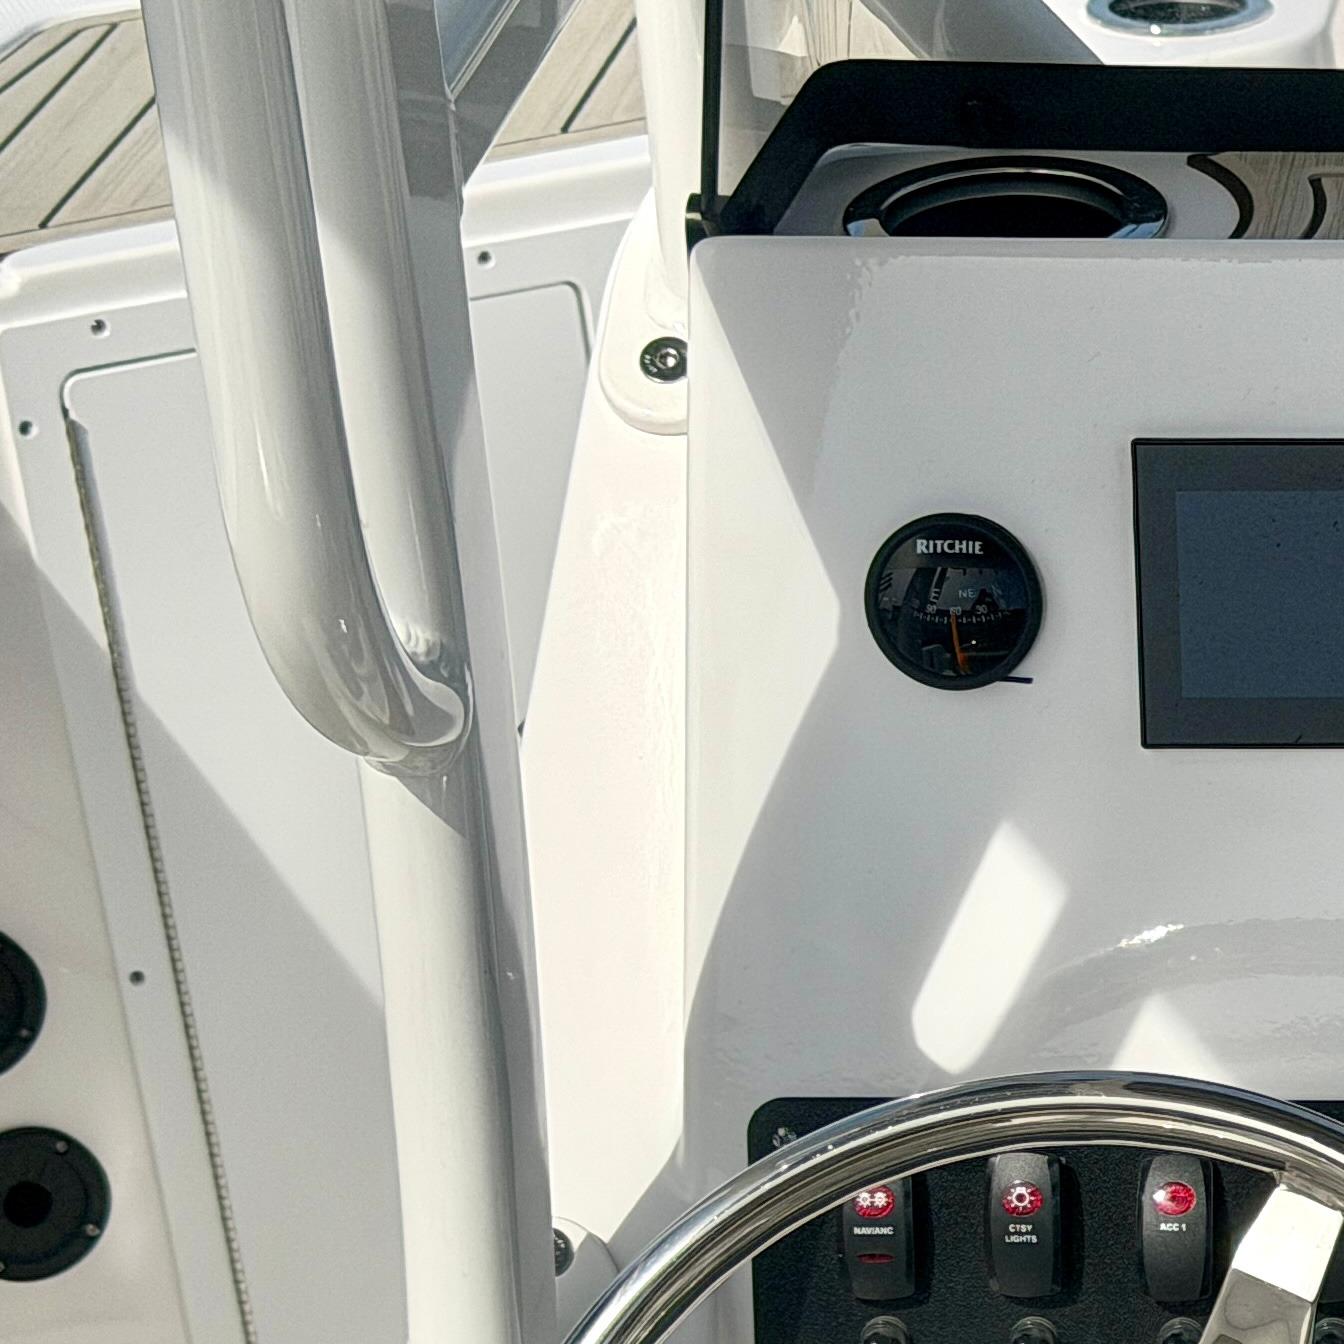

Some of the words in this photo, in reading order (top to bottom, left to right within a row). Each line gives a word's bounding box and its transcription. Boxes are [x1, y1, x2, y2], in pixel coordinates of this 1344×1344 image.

[916, 539, 984, 554] RITCHIE
[1009, 1224, 1032, 1232] CTSY
[1160, 1223, 1179, 1231] ACC
[1181, 1223, 1187, 1231] 1
[1005, 1235, 1037, 1243] LIGHTS
